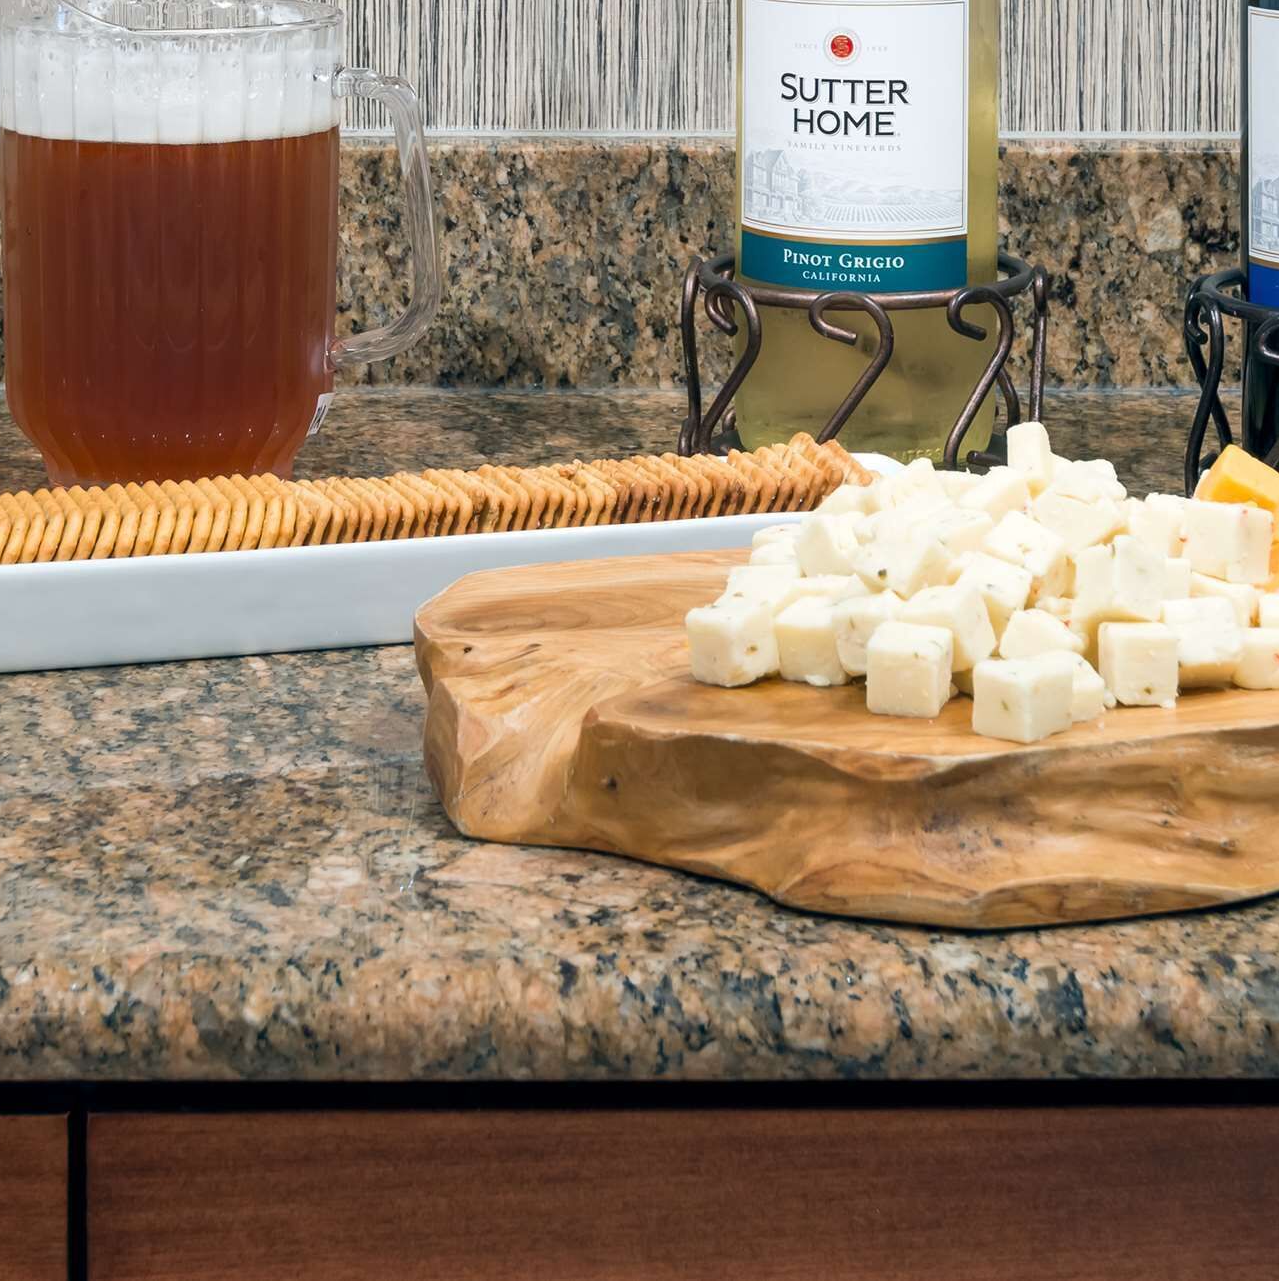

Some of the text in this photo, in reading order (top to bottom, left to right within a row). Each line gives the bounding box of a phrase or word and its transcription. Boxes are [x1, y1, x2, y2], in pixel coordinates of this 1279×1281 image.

[780, 73, 910, 104] SUTTER
[793, 108, 896, 136] HOME
[787, 140, 902, 152] FAMILY VINEYARDS
[783, 249, 905, 269] PINOT GRIGIO
[803, 270, 881, 282] CALIFORNIA
